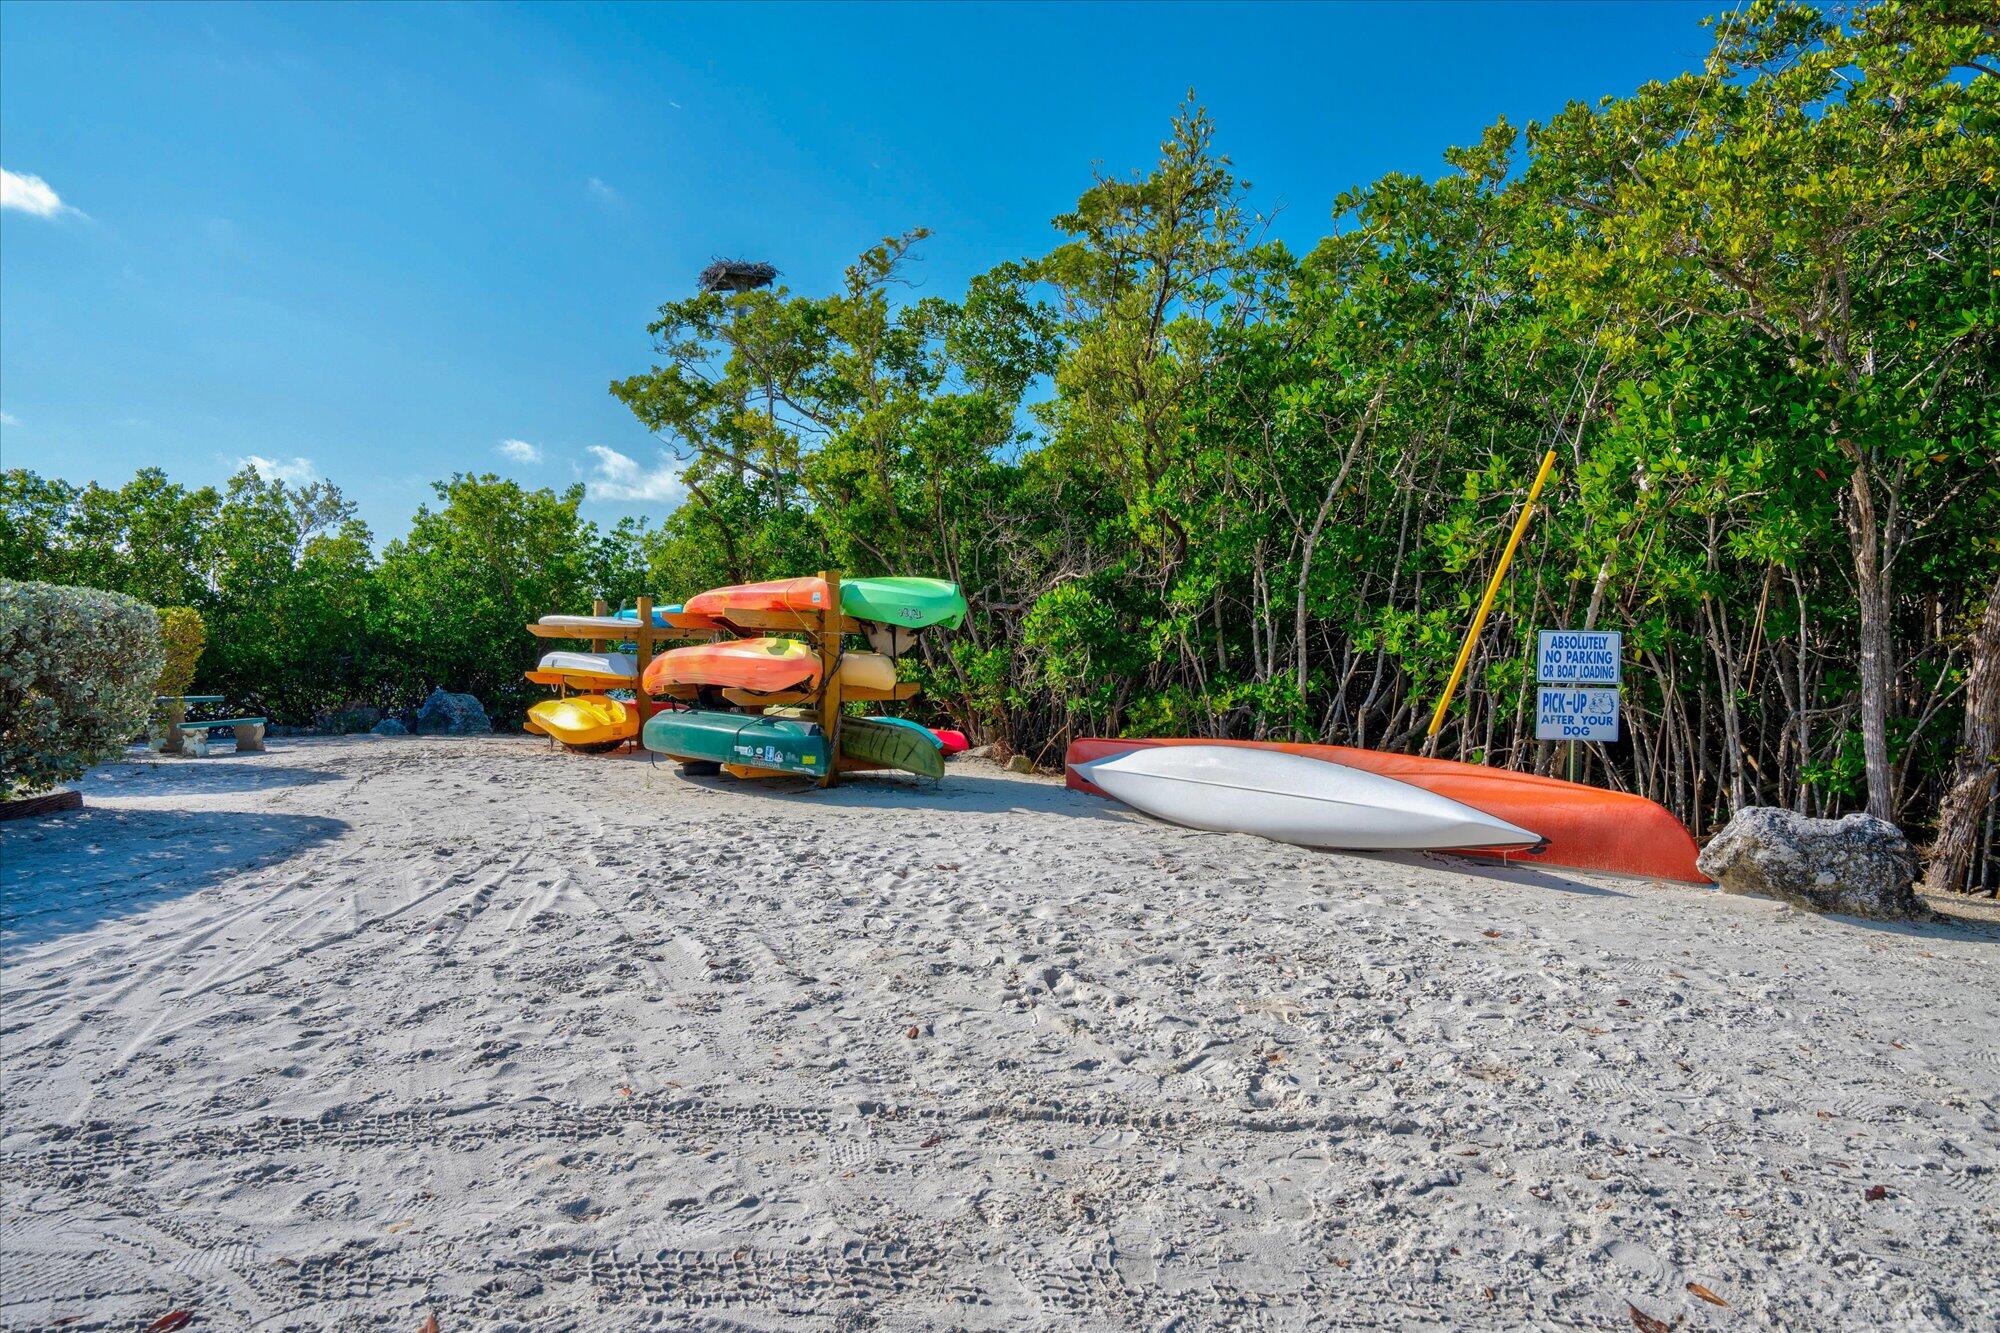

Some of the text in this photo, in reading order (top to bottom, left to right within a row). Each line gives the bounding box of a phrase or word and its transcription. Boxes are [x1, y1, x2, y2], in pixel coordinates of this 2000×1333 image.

[1551, 636, 1608, 649] ABSOLUTELY
[1546, 651, 1612, 664] NO PARKING
[1543, 665, 1614, 679] OR BOAT LOADING
[1543, 693, 1587, 713] PICK-UP
[1541, 715, 1613, 725] AFTER YOUR
[1564, 726, 1590, 735] DOG
